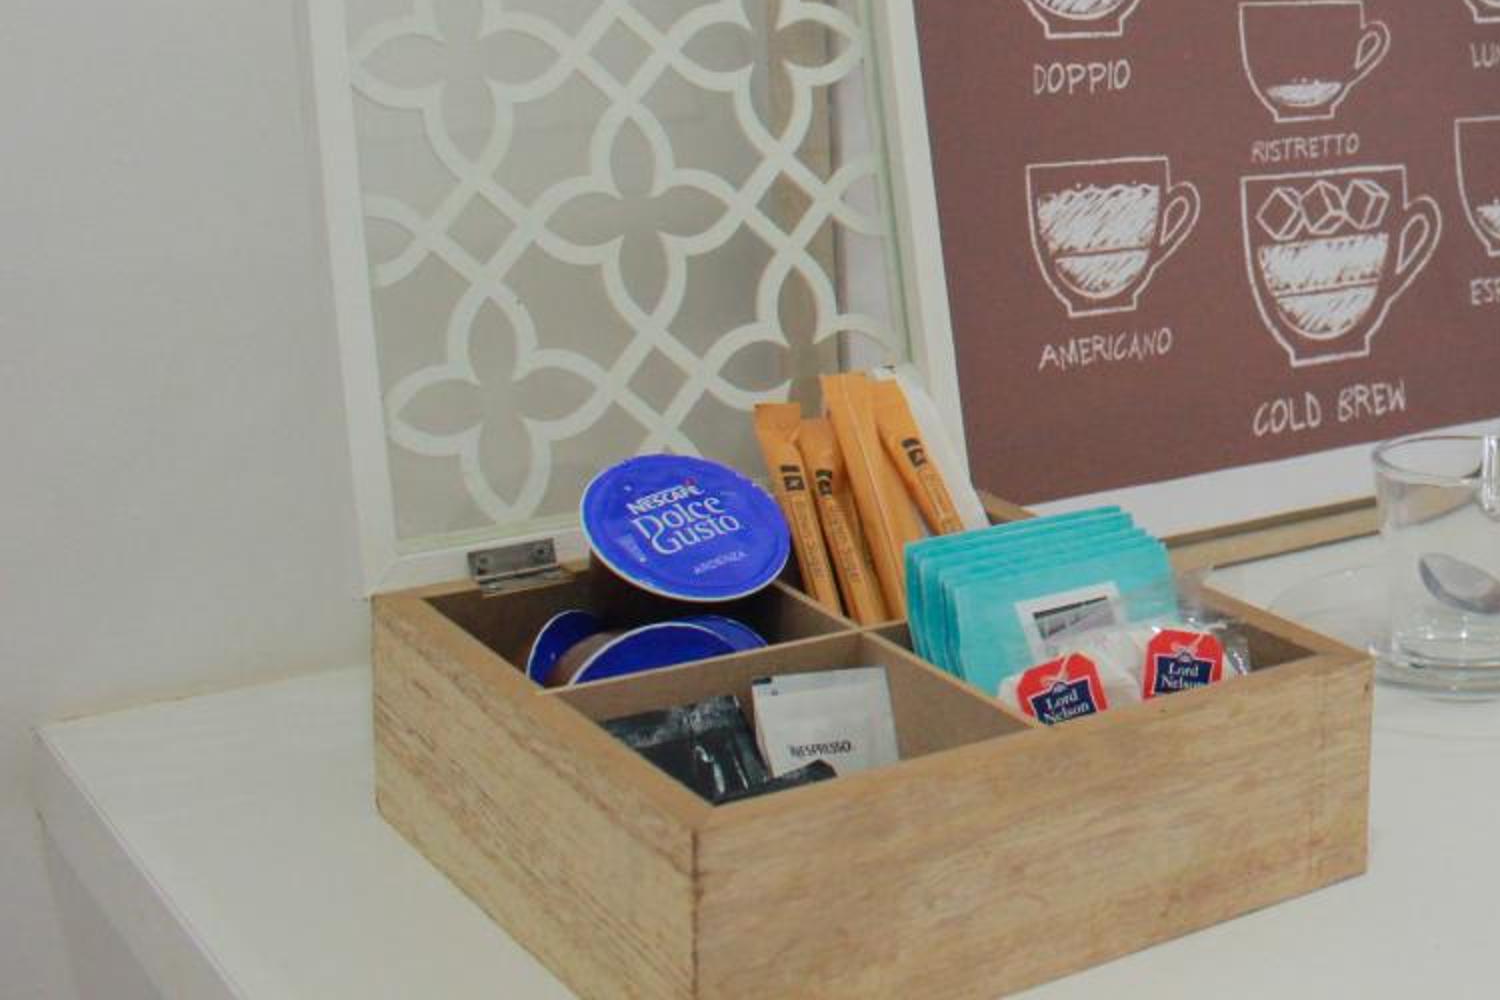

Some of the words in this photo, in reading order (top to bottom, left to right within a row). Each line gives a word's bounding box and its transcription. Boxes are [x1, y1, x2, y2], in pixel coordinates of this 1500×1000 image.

[1034, 59, 1130, 94] DOPPIO
[1252, 133, 1359, 162] RISTRETTO
[1039, 328, 1171, 370] AMERICANO
[1253, 392, 1321, 436] COLD
[1338, 381, 1405, 422] BREW
[632, 496, 726, 539] Dolce
[652, 515, 742, 555] Gusto
[1168, 661, 1200, 677] Lord
[1046, 689, 1079, 708] Lord
[790, 740, 852, 757] NESPRESSO
